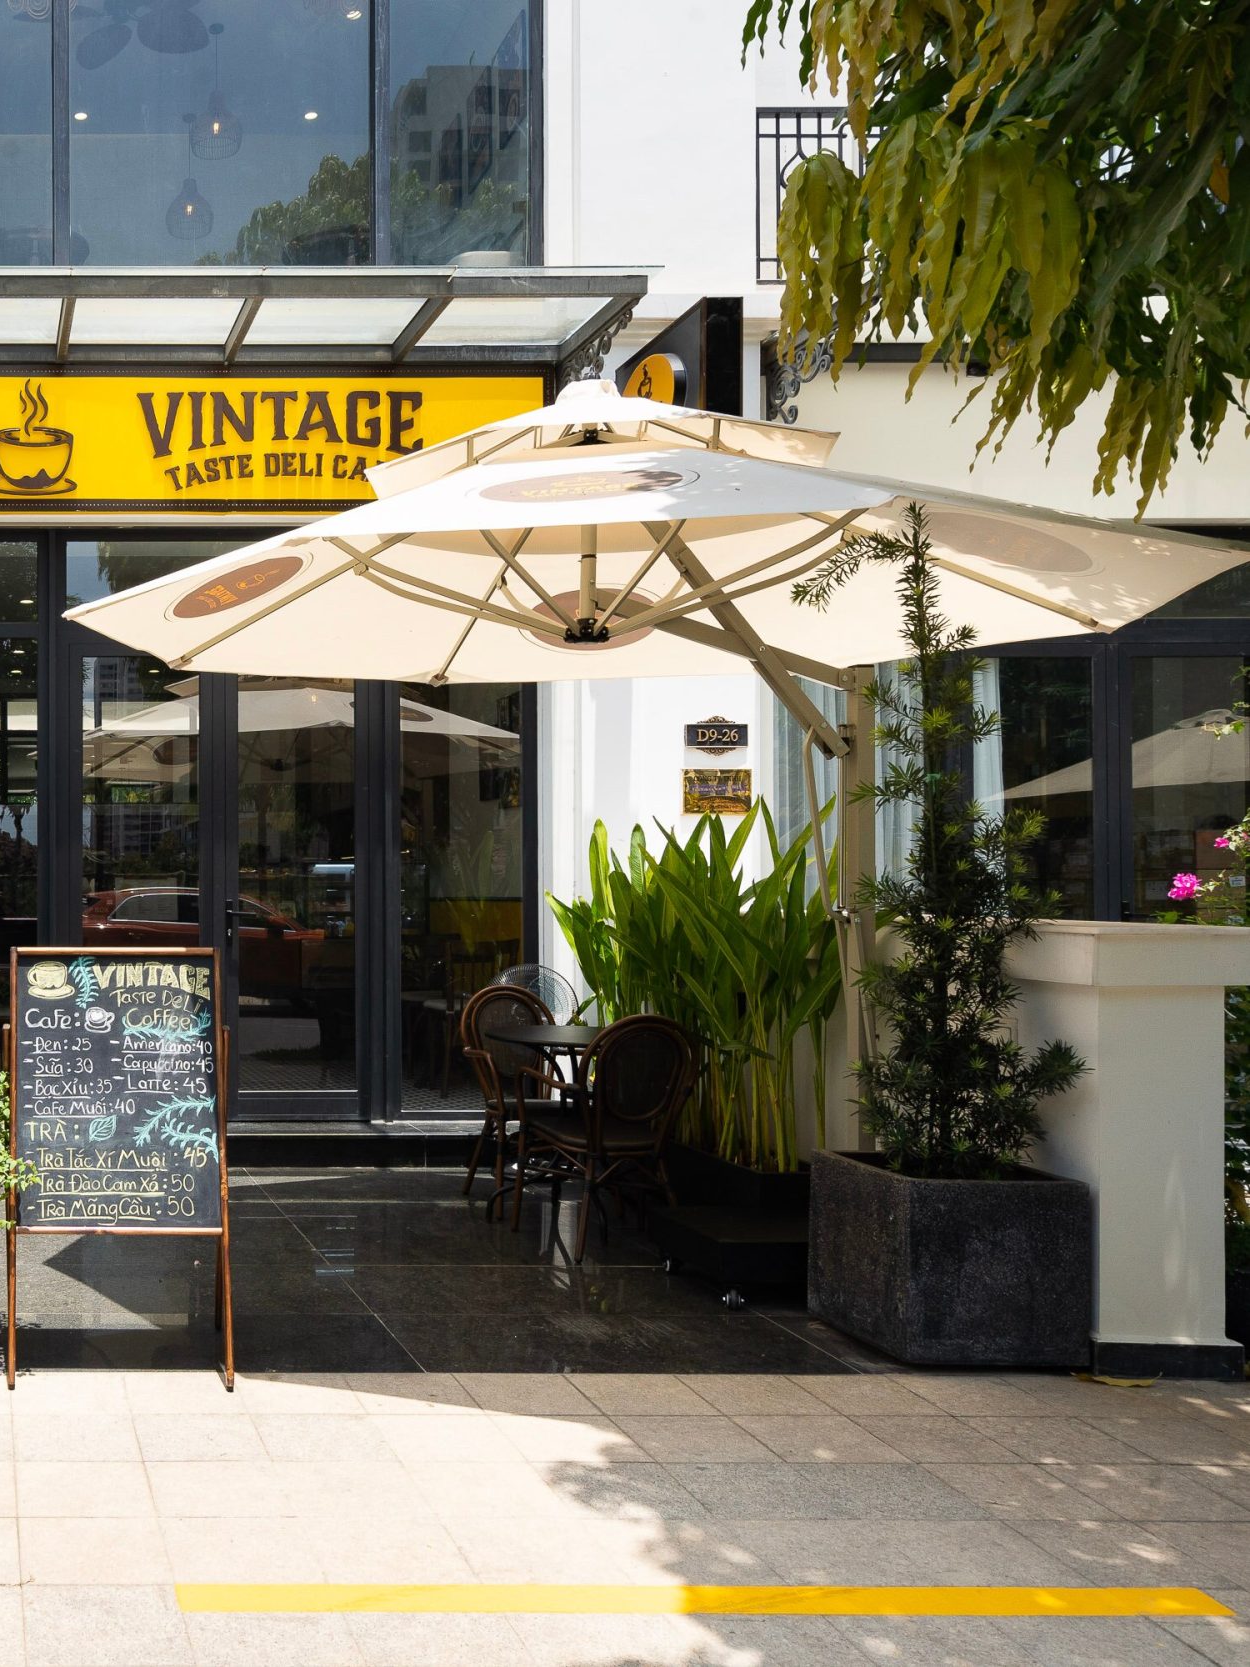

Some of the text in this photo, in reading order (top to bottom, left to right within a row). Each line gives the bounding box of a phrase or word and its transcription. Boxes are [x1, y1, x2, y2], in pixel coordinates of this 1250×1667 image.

[136, 389, 424, 460] VINTAGE
[164, 453, 254, 492] TASTE
[264, 452, 324, 478] DELI
[696, 728, 739, 742] D9-26
[92, 961, 211, 1001] VINTAGE
[72, 1037, 92, 1052] 25
[196, 1039, 213, 1055] 40
[74, 1057, 94, 1074] 30
[195, 1057, 214, 1074] 45
[95, 1078, 113, 1094] 35
[183, 1076, 208, 1094] 45
[114, 1098, 137, 1115] 40
[183, 1146, 208, 1168] 45
[68, 1173, 101, 1193] Đào
[103, 1174, 137, 1192] Cam
[171, 1173, 195, 1192] 50
[167, 1195, 195, 1217] 50
